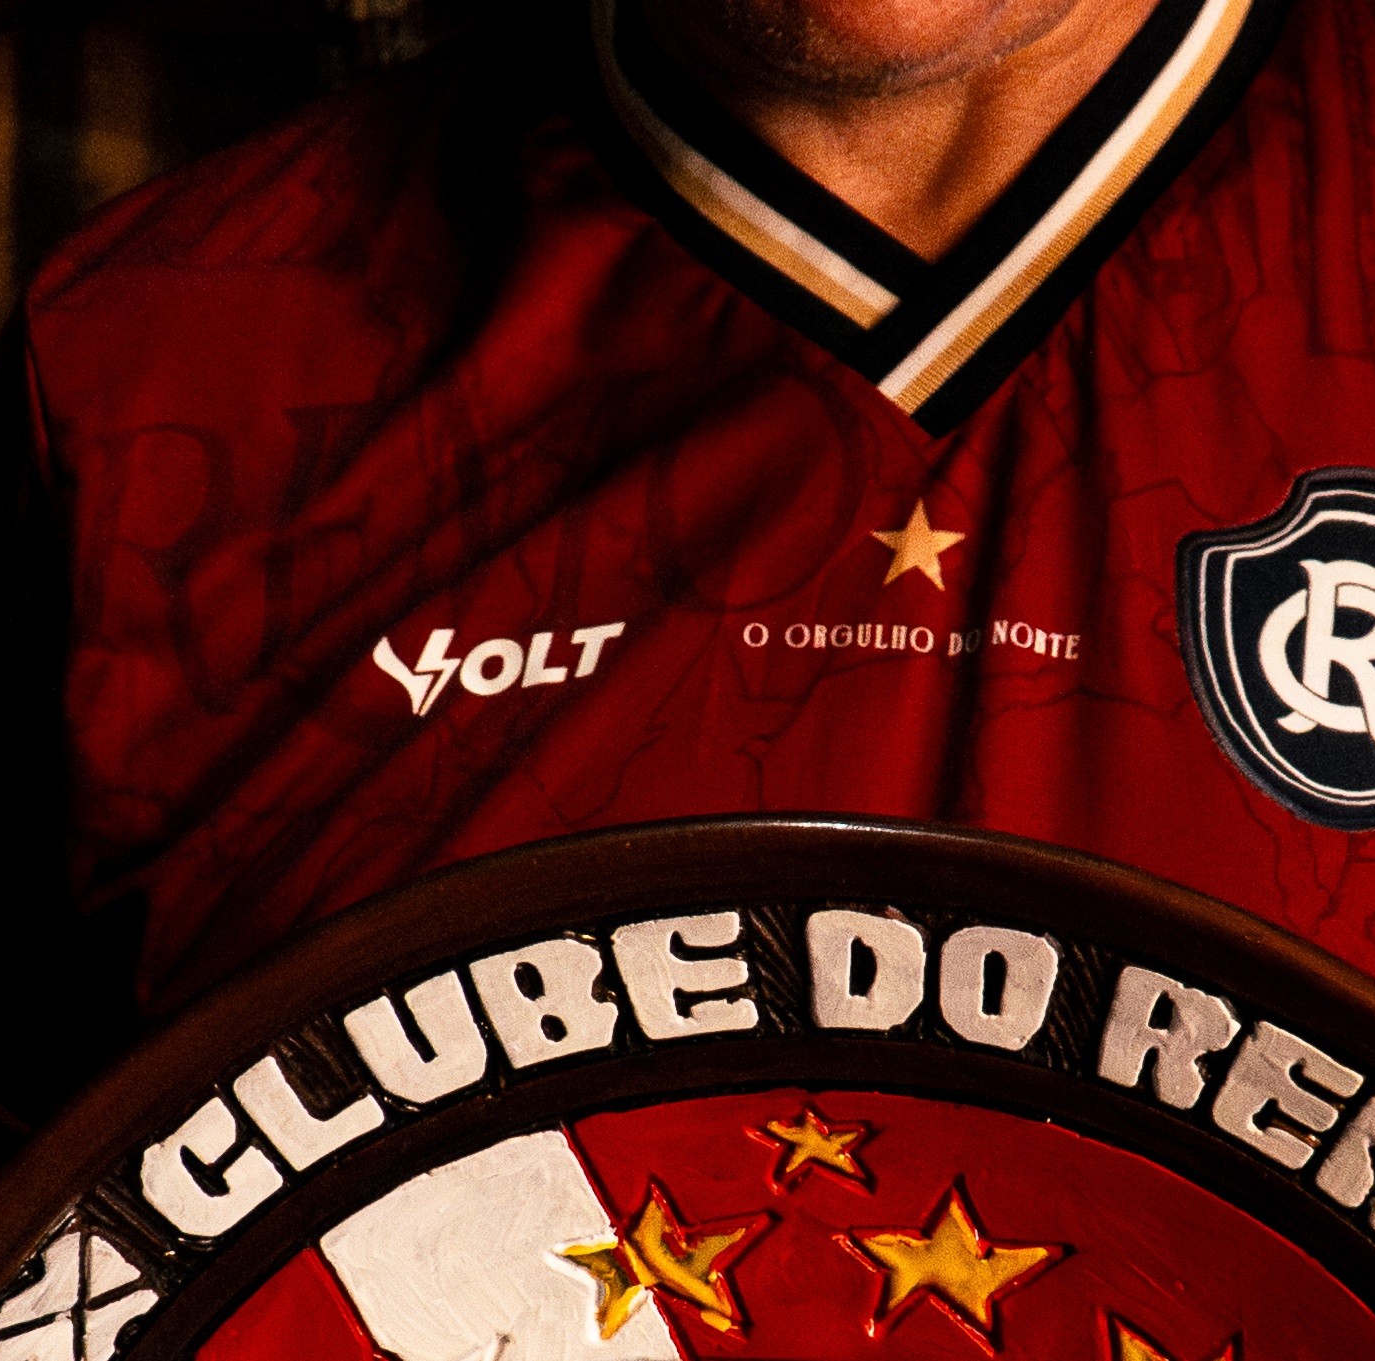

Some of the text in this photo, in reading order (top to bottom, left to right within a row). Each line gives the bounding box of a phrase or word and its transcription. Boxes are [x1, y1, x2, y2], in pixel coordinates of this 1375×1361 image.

[372, 621, 626, 717] VOLT
[742, 619, 1082, 661] O ORGULHO DO NORTE
[138, 910, 759, 1239] CLUBE
[805, 908, 1061, 1053] DO
